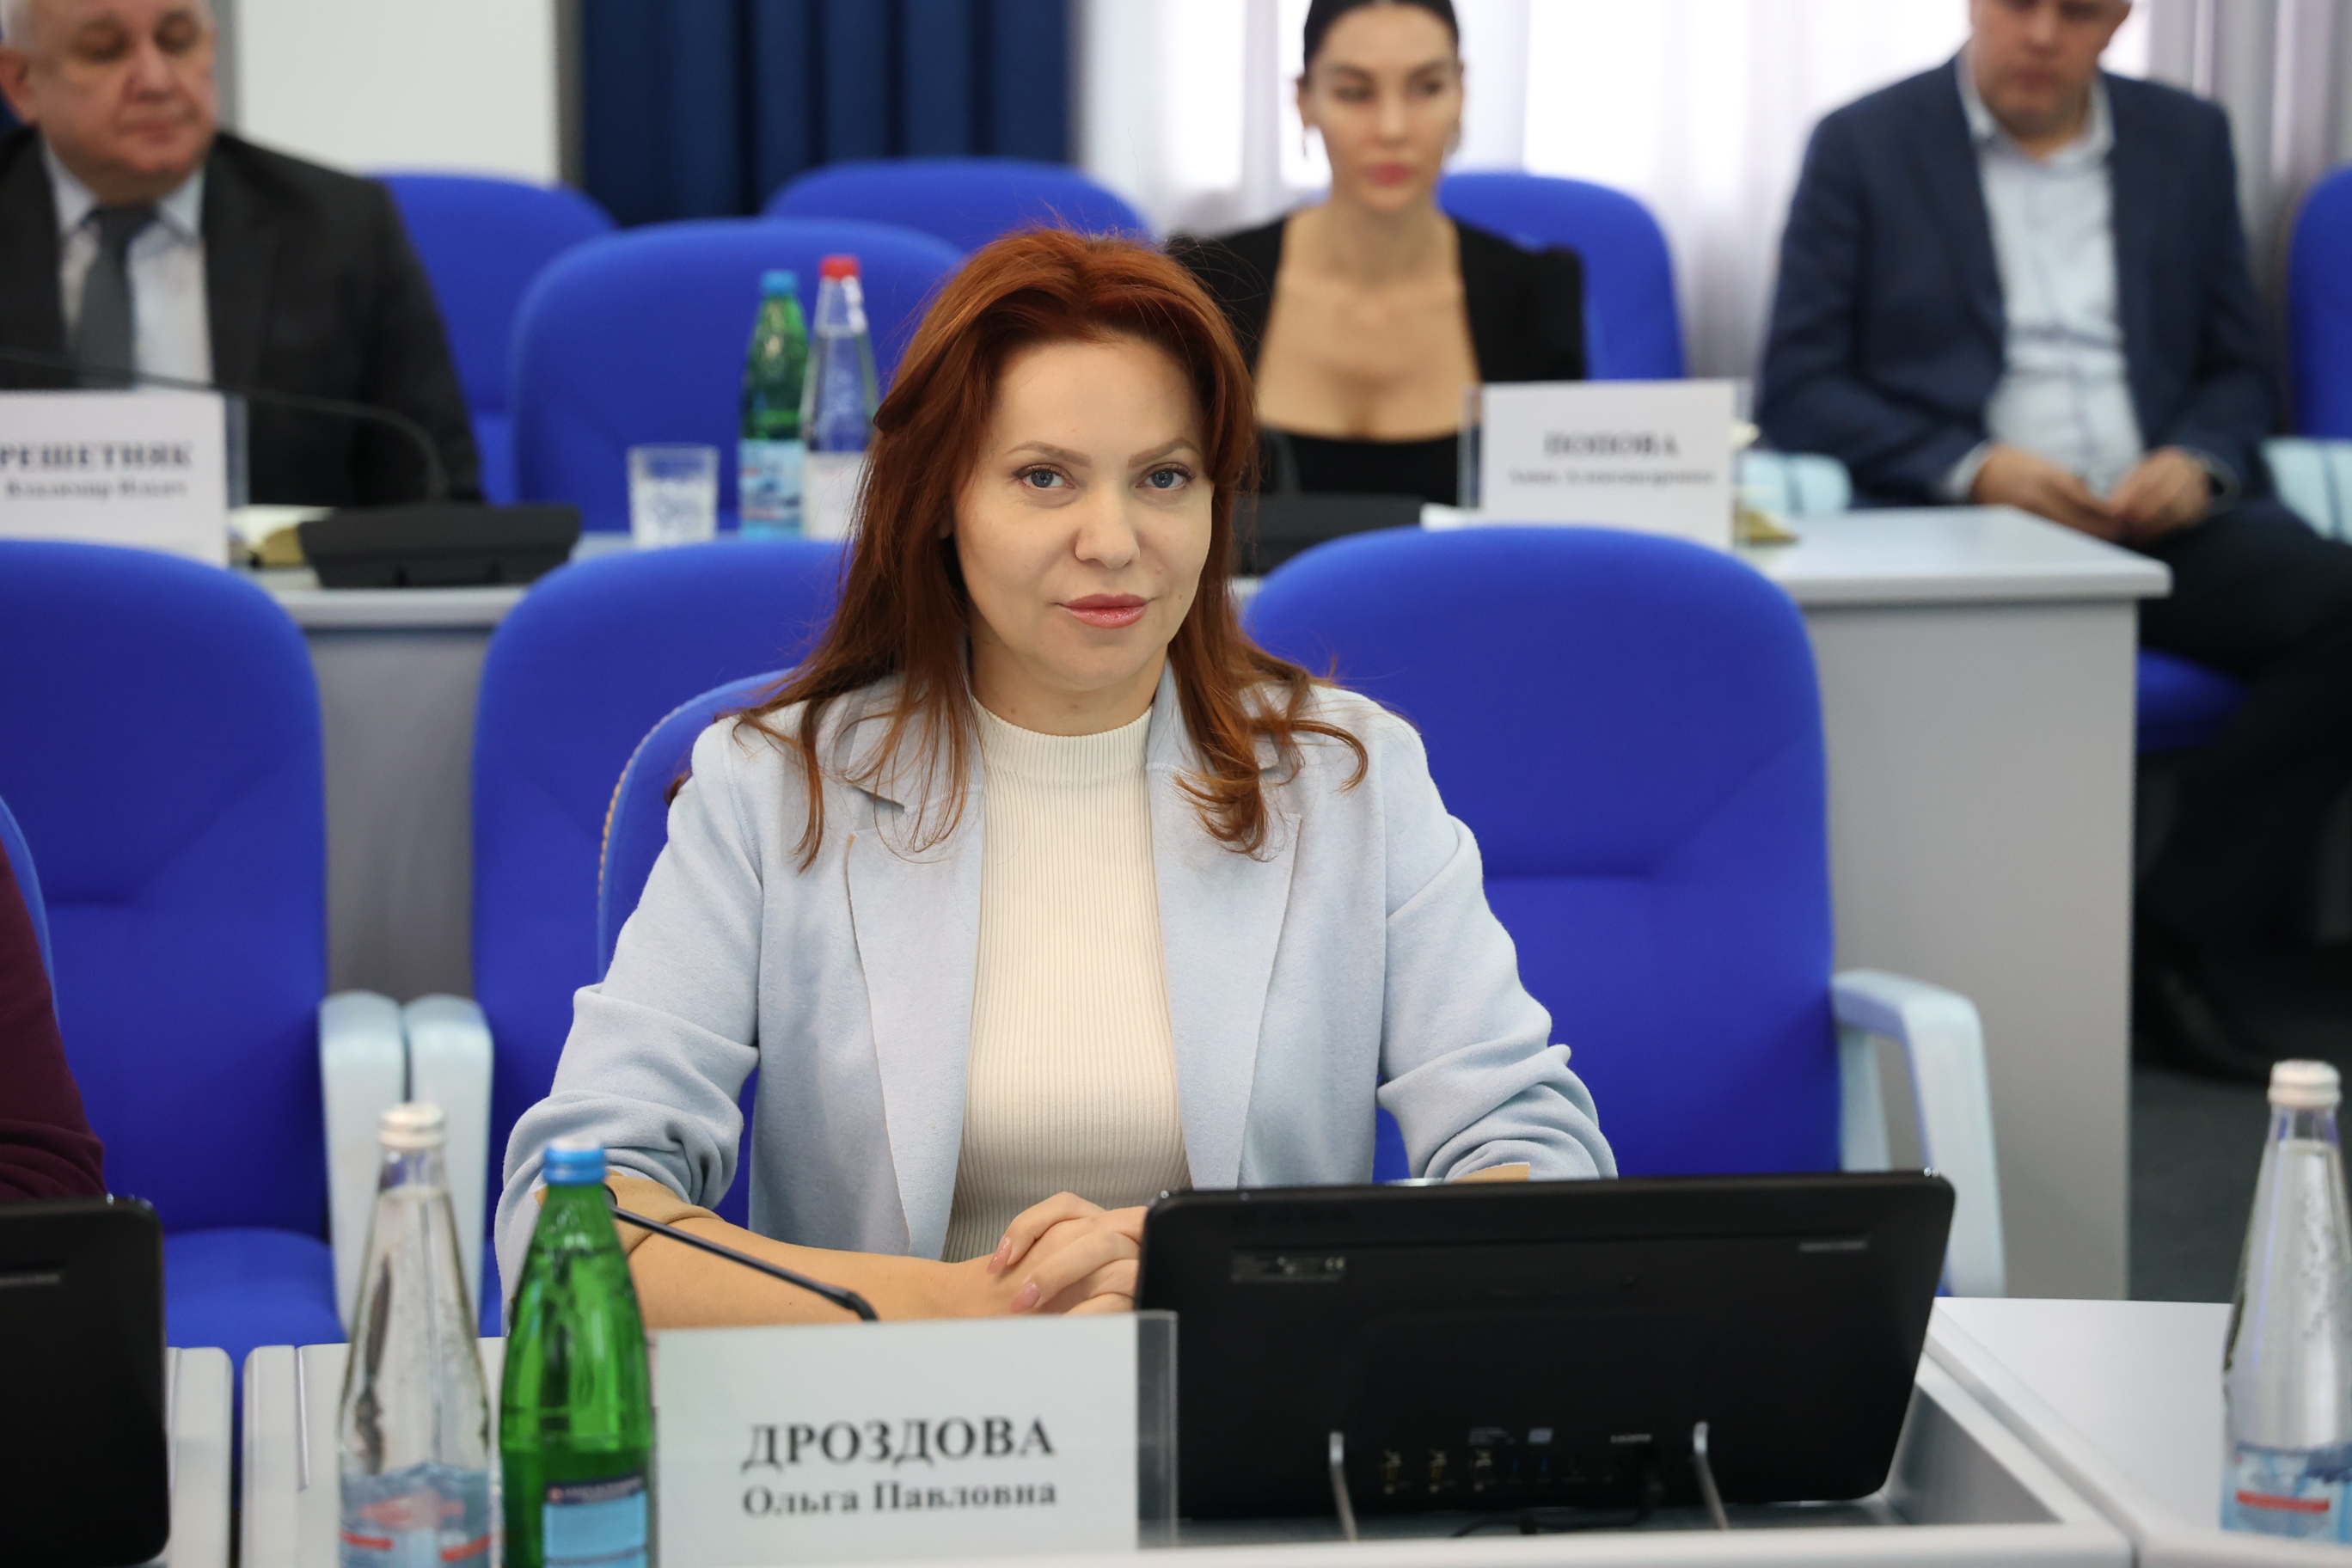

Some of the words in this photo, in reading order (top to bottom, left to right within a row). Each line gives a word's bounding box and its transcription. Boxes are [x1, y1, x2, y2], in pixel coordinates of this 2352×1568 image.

[1545, 432, 1679, 457] ПОПОВА
[743, 1416, 1055, 1472] ДРОЗДОВА
[743, 1484, 859, 1517] Ольга
[873, 1480, 1056, 1513] Павловна
